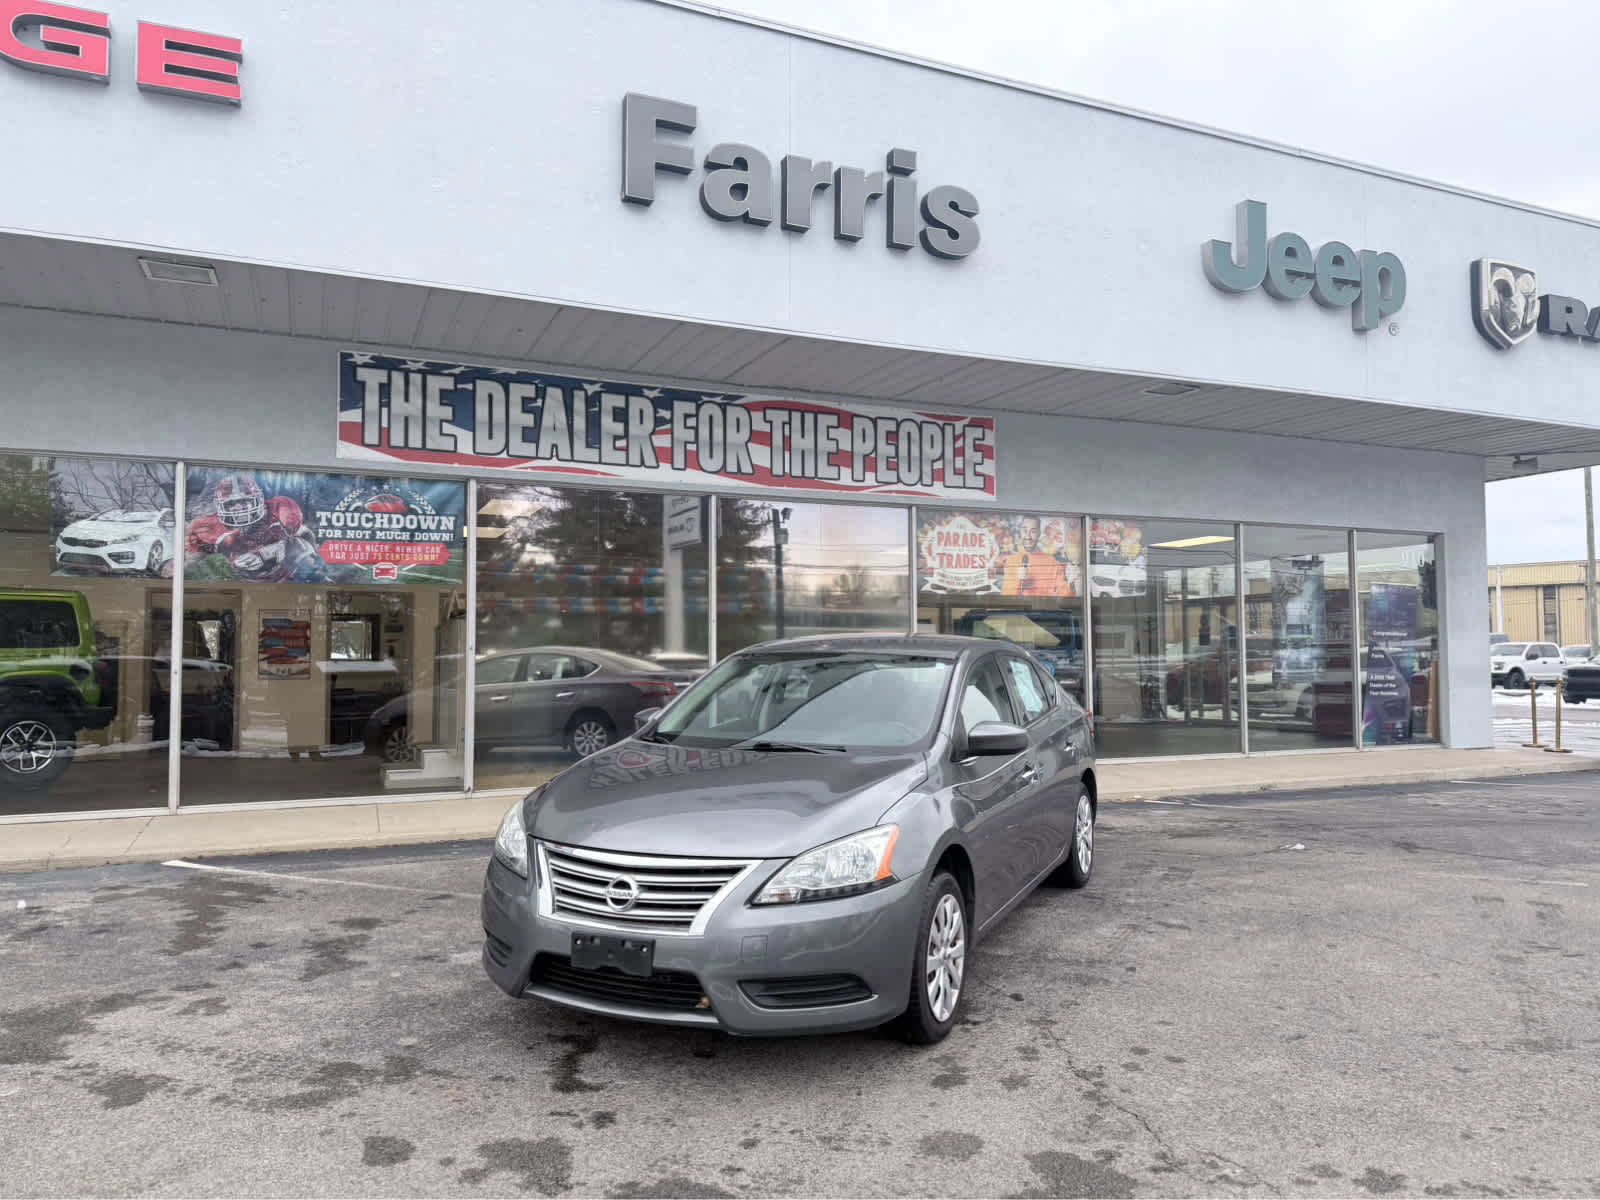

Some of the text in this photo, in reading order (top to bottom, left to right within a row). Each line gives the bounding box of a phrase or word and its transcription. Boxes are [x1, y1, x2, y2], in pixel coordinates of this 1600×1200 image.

[621, 91, 981, 260] Farris
[1201, 199, 1407, 331] Jeep
[355, 366, 986, 489] THE DEALER FOR THE PEOPLE
[316, 511, 456, 530] TOUCHDOWN
[318, 529, 454, 541] FOR NOT MUCH DOWN!
[937, 532, 986, 548] PARADE
[328, 543, 353, 552] DRIVE
[356, 544, 362, 552] A
[396, 545, 422, 553] NEWER
[425, 545, 441, 554] CAR
[329, 552, 346, 560] FOR
[349, 552, 369, 560] JUST
[936, 552, 986, 569] TRADES
